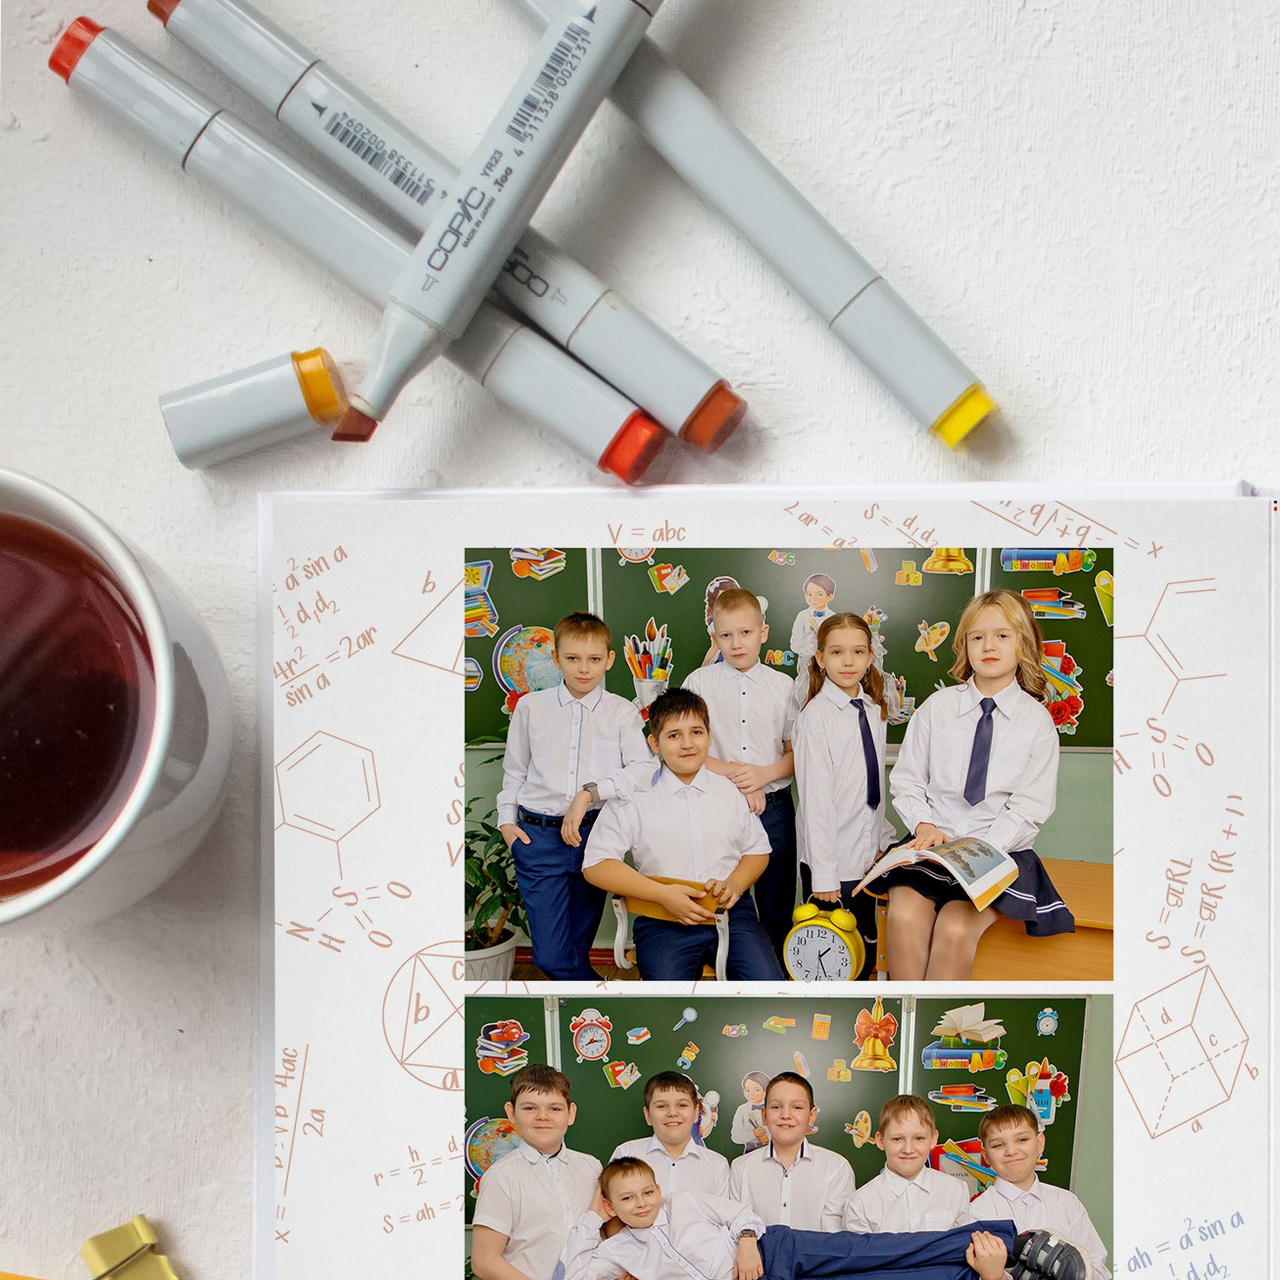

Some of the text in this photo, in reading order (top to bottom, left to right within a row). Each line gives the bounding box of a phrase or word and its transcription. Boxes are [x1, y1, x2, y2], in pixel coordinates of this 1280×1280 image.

[480, 149, 504, 178] YR23
[427, 186, 486, 272] COPIC
[461, 226, 479, 249] MADE
[479, 196, 496, 223] JAPAN
[863, 503, 880, 520] S
[607, 519, 687, 545] V abc
[302, 555, 330, 581] sin
[767, 549, 796, 566] 456
[1054, 549, 1097, 576] ABC
[421, 570, 437, 594] b
[338, 626, 379, 660] 2ar
[764, 649, 795, 667] ABC
[284, 684, 314, 708] sin
[1146, 717, 1168, 744] S
[331, 885, 359, 907] S
[413, 992, 431, 1025] b
[1160, 1006, 1173, 1026] d
[721, 1023, 749, 1038] 456
[1208, 1033, 1218, 1047] c
[676, 1040, 700, 1070] ABC
[968, 1049, 1008, 1073] ABC
[1244, 1062, 1260, 1081] b
[413, 1167, 428, 1186] 2
[382, 1202, 437, 1234] S ah
[1127, 1247, 1153, 1274] ah
[1198, 1219, 1226, 1242] sin
